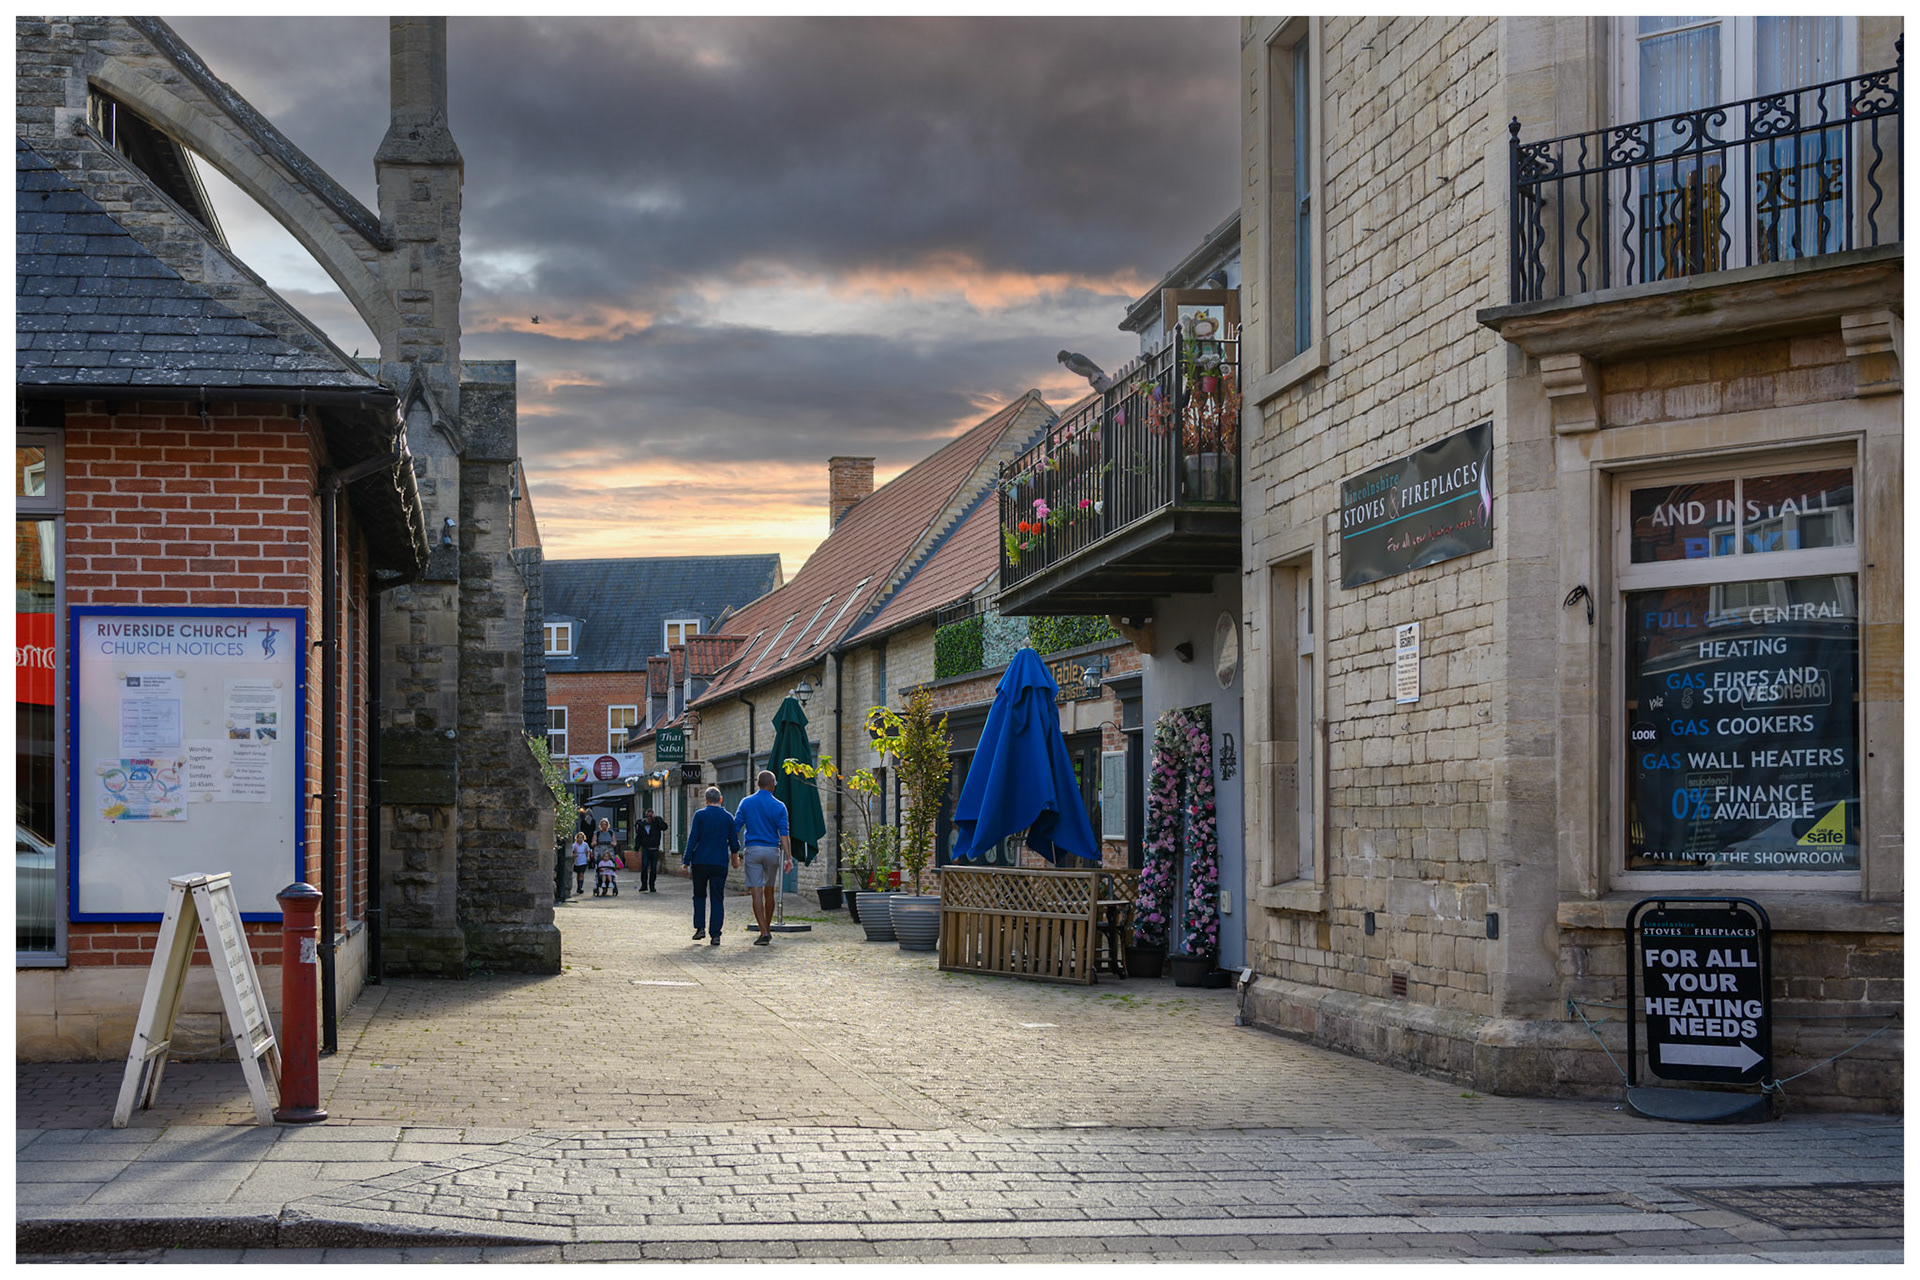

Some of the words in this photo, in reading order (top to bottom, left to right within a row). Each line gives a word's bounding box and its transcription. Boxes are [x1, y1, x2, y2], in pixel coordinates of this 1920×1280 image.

[1344, 473, 1400, 507] Lincolnshire
[1344, 497, 1385, 529] STOVES
[1388, 486, 1400, 519] &
[1401, 461, 1478, 509] FIREPLACES
[1651, 500, 1705, 527] AND
[1401, 532, 1411, 549] all
[1645, 611, 1697, 629] FULL
[1703, 610, 1742, 628] GAS
[1749, 601, 1844, 625] CENTRAL
[97, 623, 175, 637] RIVERSIDE
[180, 624, 247, 638] CHURCH
[101, 641, 171, 655] CHURCH
[176, 642, 244, 656] NOTICES
[1699, 637, 1787, 659] HEATING
[1666, 672, 1706, 690] GAS
[1713, 669, 1770, 689] FIRES
[1775, 666, 1819, 685] AND
[1703, 685, 1780, 705] STOVES
[1632, 730, 1656, 741] LOOK
[1670, 718, 1710, 737] GAS
[1716, 714, 1815, 735] COOKERS
[659, 732, 682, 741] Thai
[658, 743, 684, 753] Sabai
[1642, 752, 1681, 770] GAS
[1687, 751, 1745, 769] WALL
[1751, 748, 1845, 768] HEATERS
[1715, 784, 1814, 802] FINANCE
[1672, 787, 1711, 820] 0%
[1713, 801, 1816, 820] AVAILABLE
[1807, 829, 1843, 843] safe
[1642, 852, 1673, 860] CALL
[1682, 852, 1716, 862] INTO
[1720, 852, 1749, 864] THE
[1754, 852, 1845, 864] SHOWROOM
[1643, 927, 1682, 936] STOVES
[1694, 928, 1756, 937] FIREPLACES
[1645, 949, 1699, 968] FOR
[1705, 949, 1757, 968] ALL
[1662, 973, 1739, 993] YOUR
[1644, 997, 1763, 1019] HEATING
[1669, 1017, 1758, 1039] NEEDS
